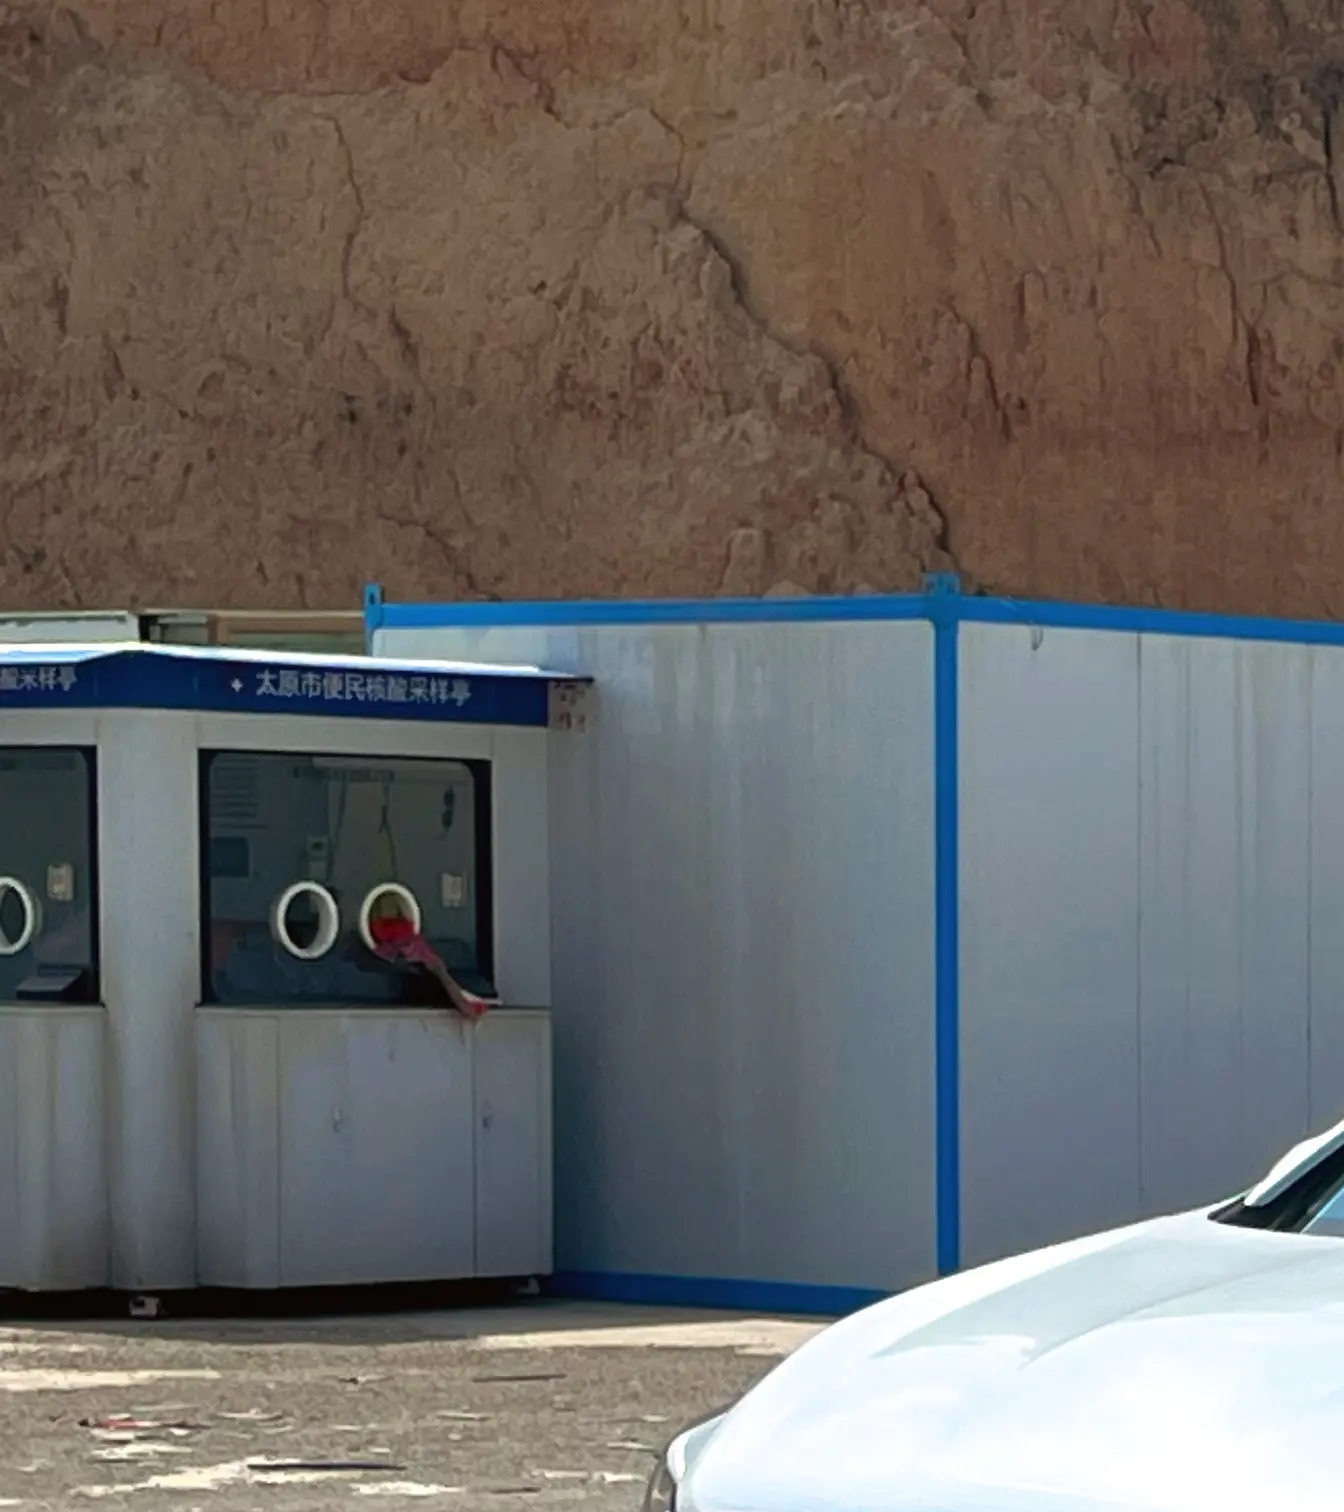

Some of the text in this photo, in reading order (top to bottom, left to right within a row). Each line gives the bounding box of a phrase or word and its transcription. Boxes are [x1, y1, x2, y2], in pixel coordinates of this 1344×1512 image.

[256, 669, 471, 707] 太原市便民核酸采样亭
